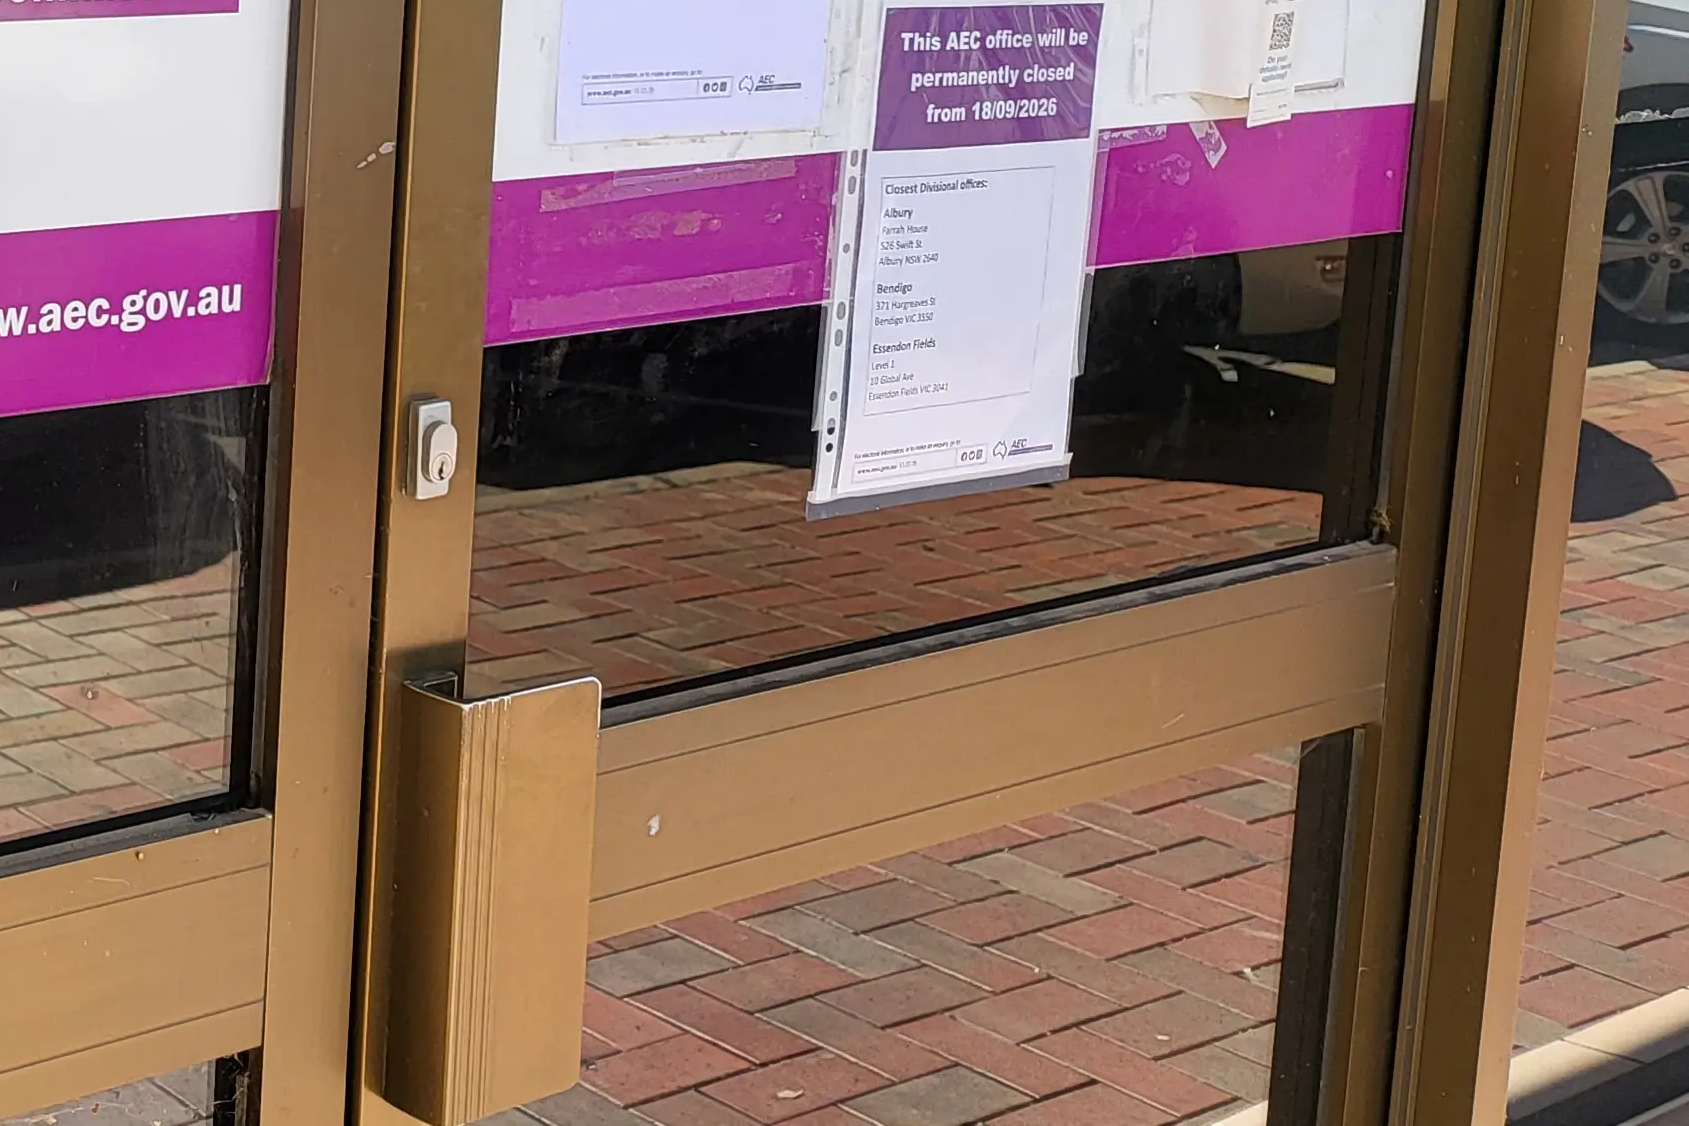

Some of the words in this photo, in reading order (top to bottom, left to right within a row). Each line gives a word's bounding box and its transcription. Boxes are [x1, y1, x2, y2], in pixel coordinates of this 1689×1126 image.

[901, 32, 941, 51] This
[946, 31, 981, 50] AEC
[986, 30, 1032, 49] office
[1038, 28, 1065, 47] will
[1069, 27, 1088, 45] be
[911, 65, 1019, 92] permanently
[1023, 62, 1075, 82] closed
[927, 104, 965, 123] from
[972, 98, 1057, 120] 18/09/2026
[885, 183, 917, 195] Closest
[920, 179, 959, 193] Divisional
[960, 178, 988, 190] offices:
[883, 208, 913, 219] Albury
[879, 256, 903, 266] Albury
[905, 255, 921, 264] NSW
[877, 282, 913, 295] Bendigo
[876, 300, 889, 310] 371
[875, 316, 904, 326] Bendigo
[905, 314, 916, 323] VIC
[917, 312, 934, 322] 3550
[873, 341, 911, 354] Essendon
[913, 337, 936, 350] Fields
[872, 360, 889, 370] Level
[902, 373, 914, 381] Ave
[869, 390, 899, 401] Essendon
[920, 384, 931, 393] VIC
